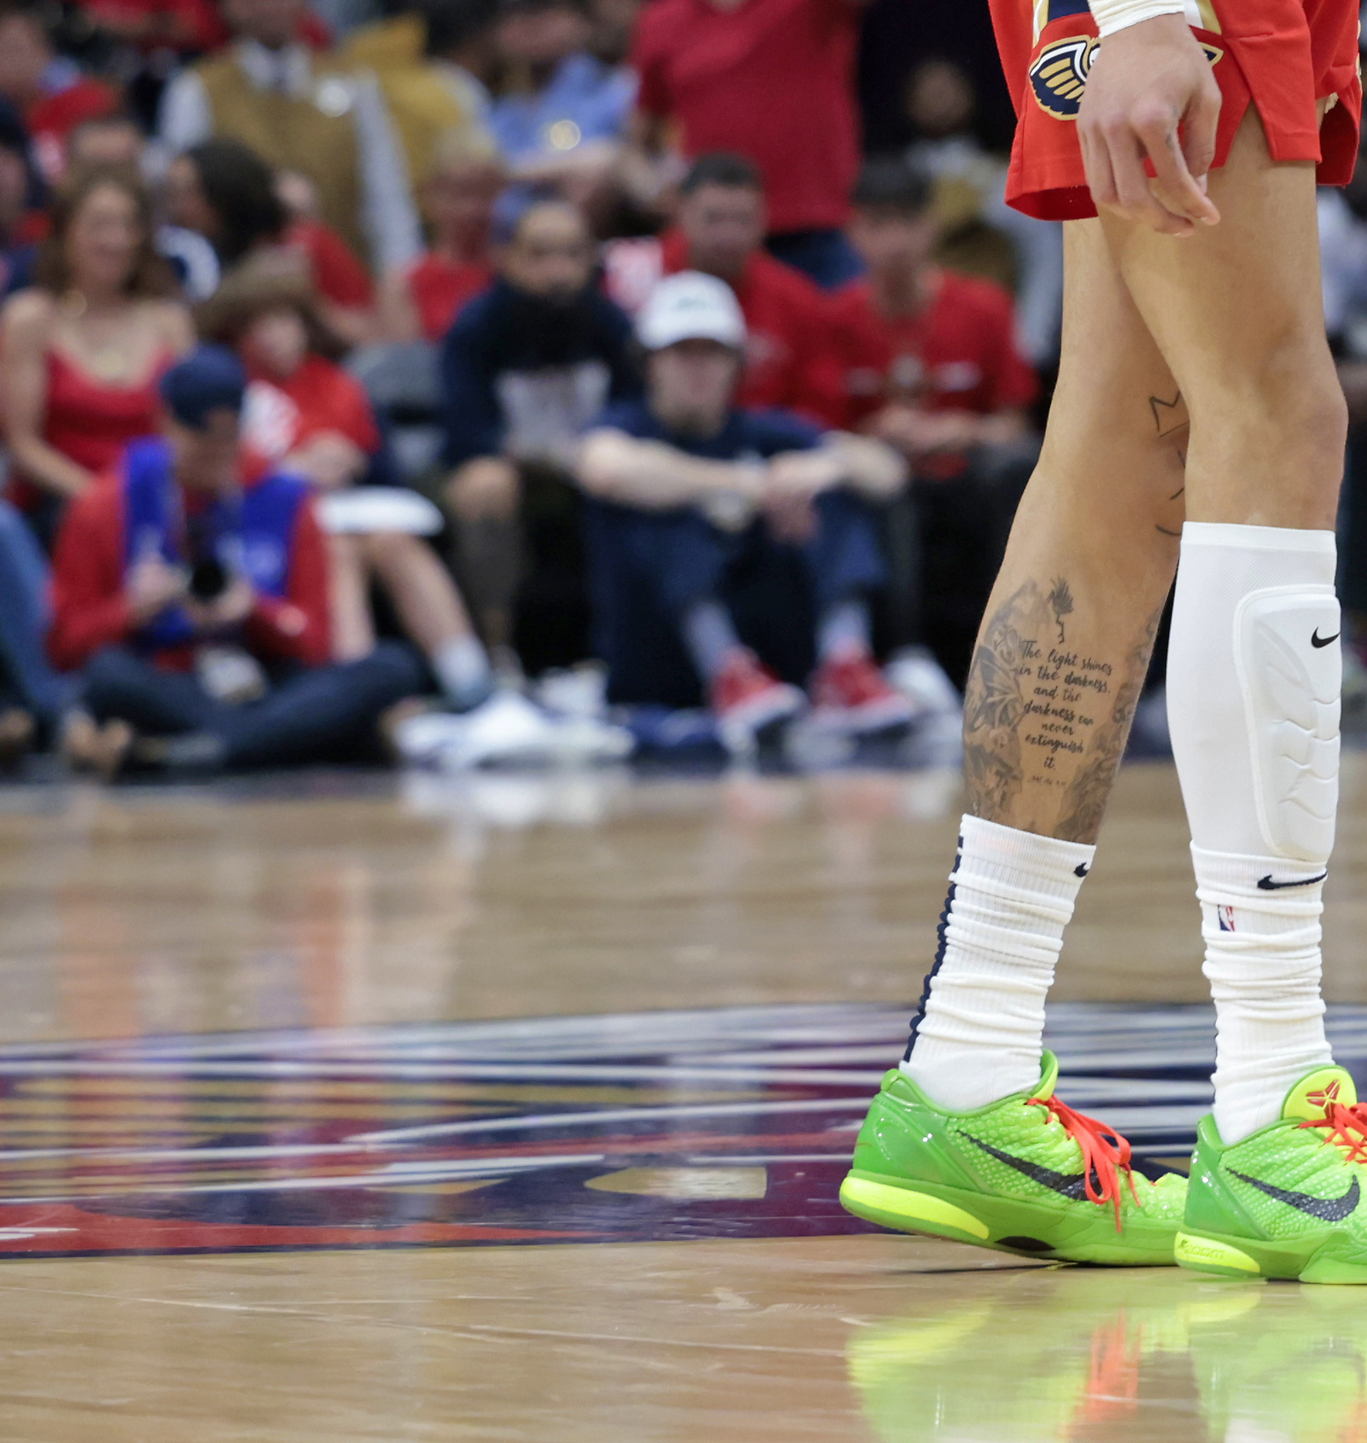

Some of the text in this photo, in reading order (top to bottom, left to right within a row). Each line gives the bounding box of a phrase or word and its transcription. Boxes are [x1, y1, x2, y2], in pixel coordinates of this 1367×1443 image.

[1021, 640, 1112, 676] The light shines
[1020, 664, 1032, 676] in
[1037, 665, 1060, 681] the
[1033, 686, 1081, 702] and the
[1023, 700, 1094, 726] darkness can
[1041, 723, 1074, 736] never
[1025, 734, 1084, 754] extinguish
